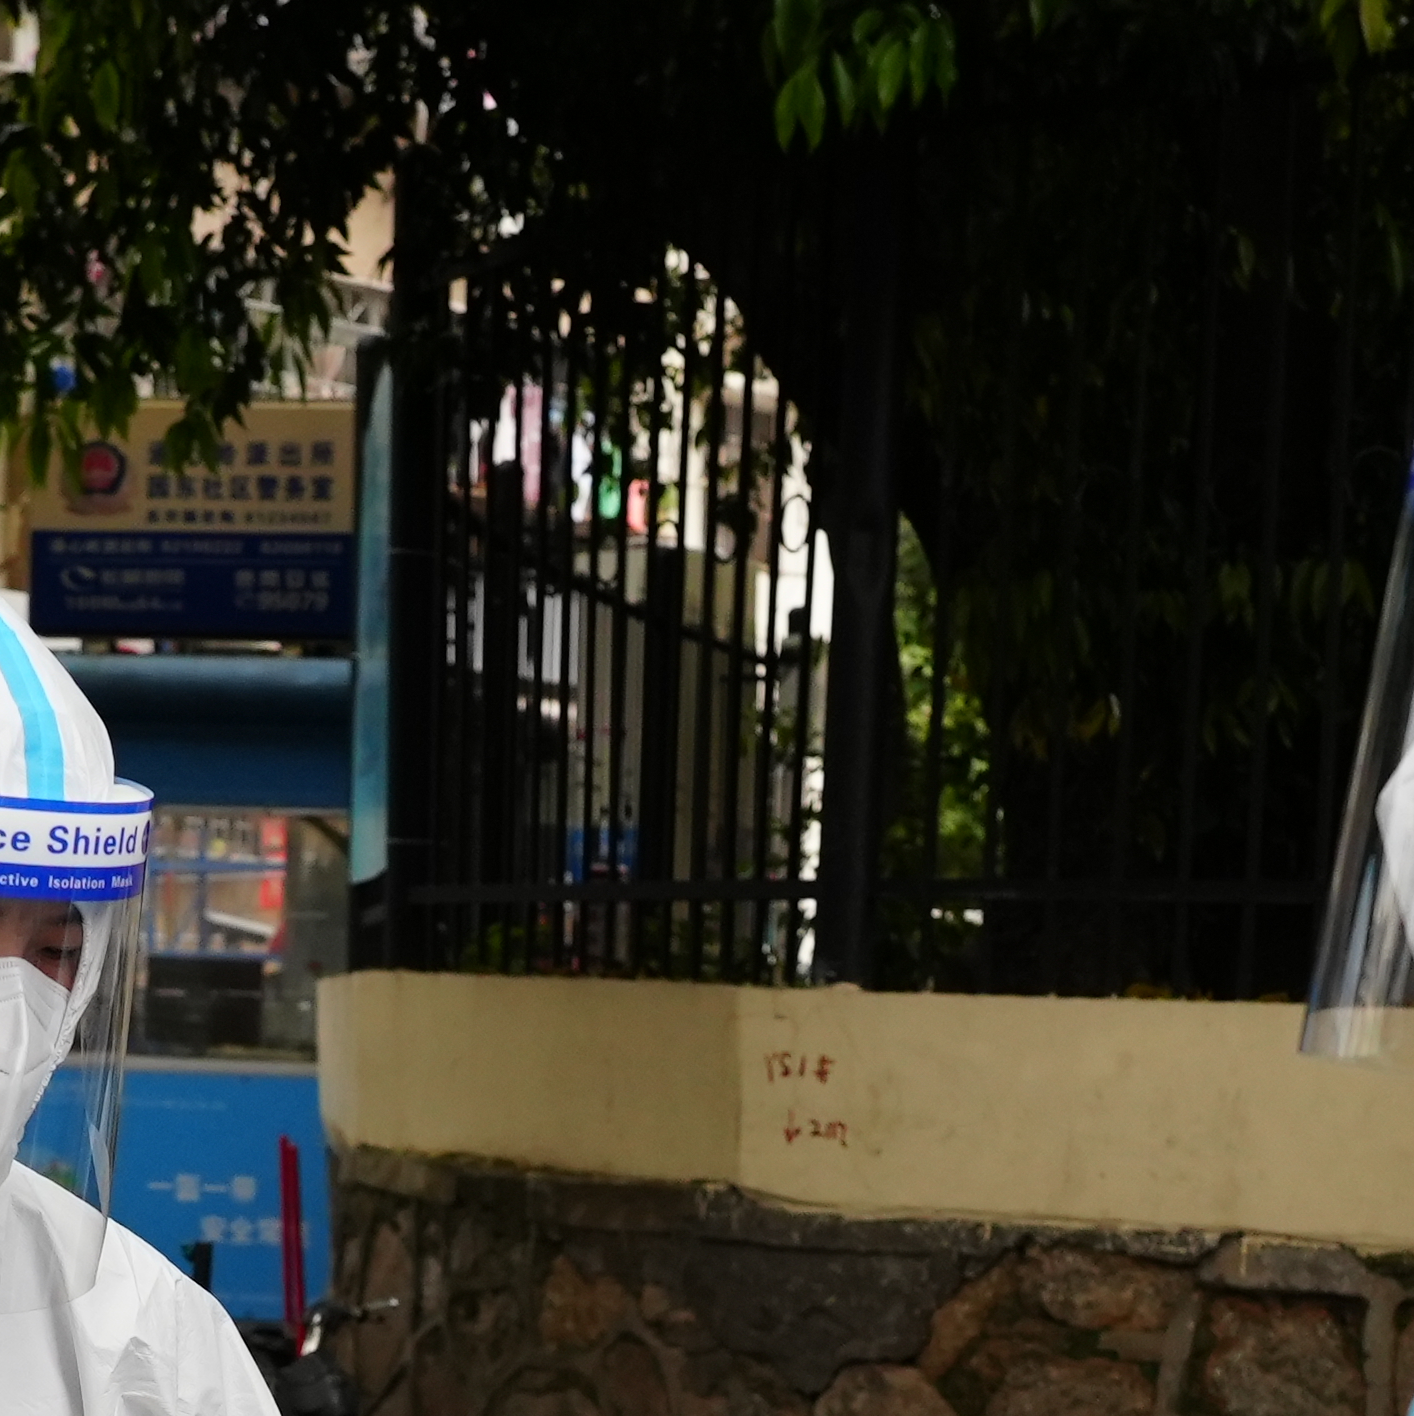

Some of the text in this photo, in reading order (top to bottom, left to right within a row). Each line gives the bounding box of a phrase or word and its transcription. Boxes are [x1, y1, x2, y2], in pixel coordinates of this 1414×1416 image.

[47, 824, 138, 855] Shield
[48, 874, 105, 890] Isolation
[111, 873, 133, 888] Mask
